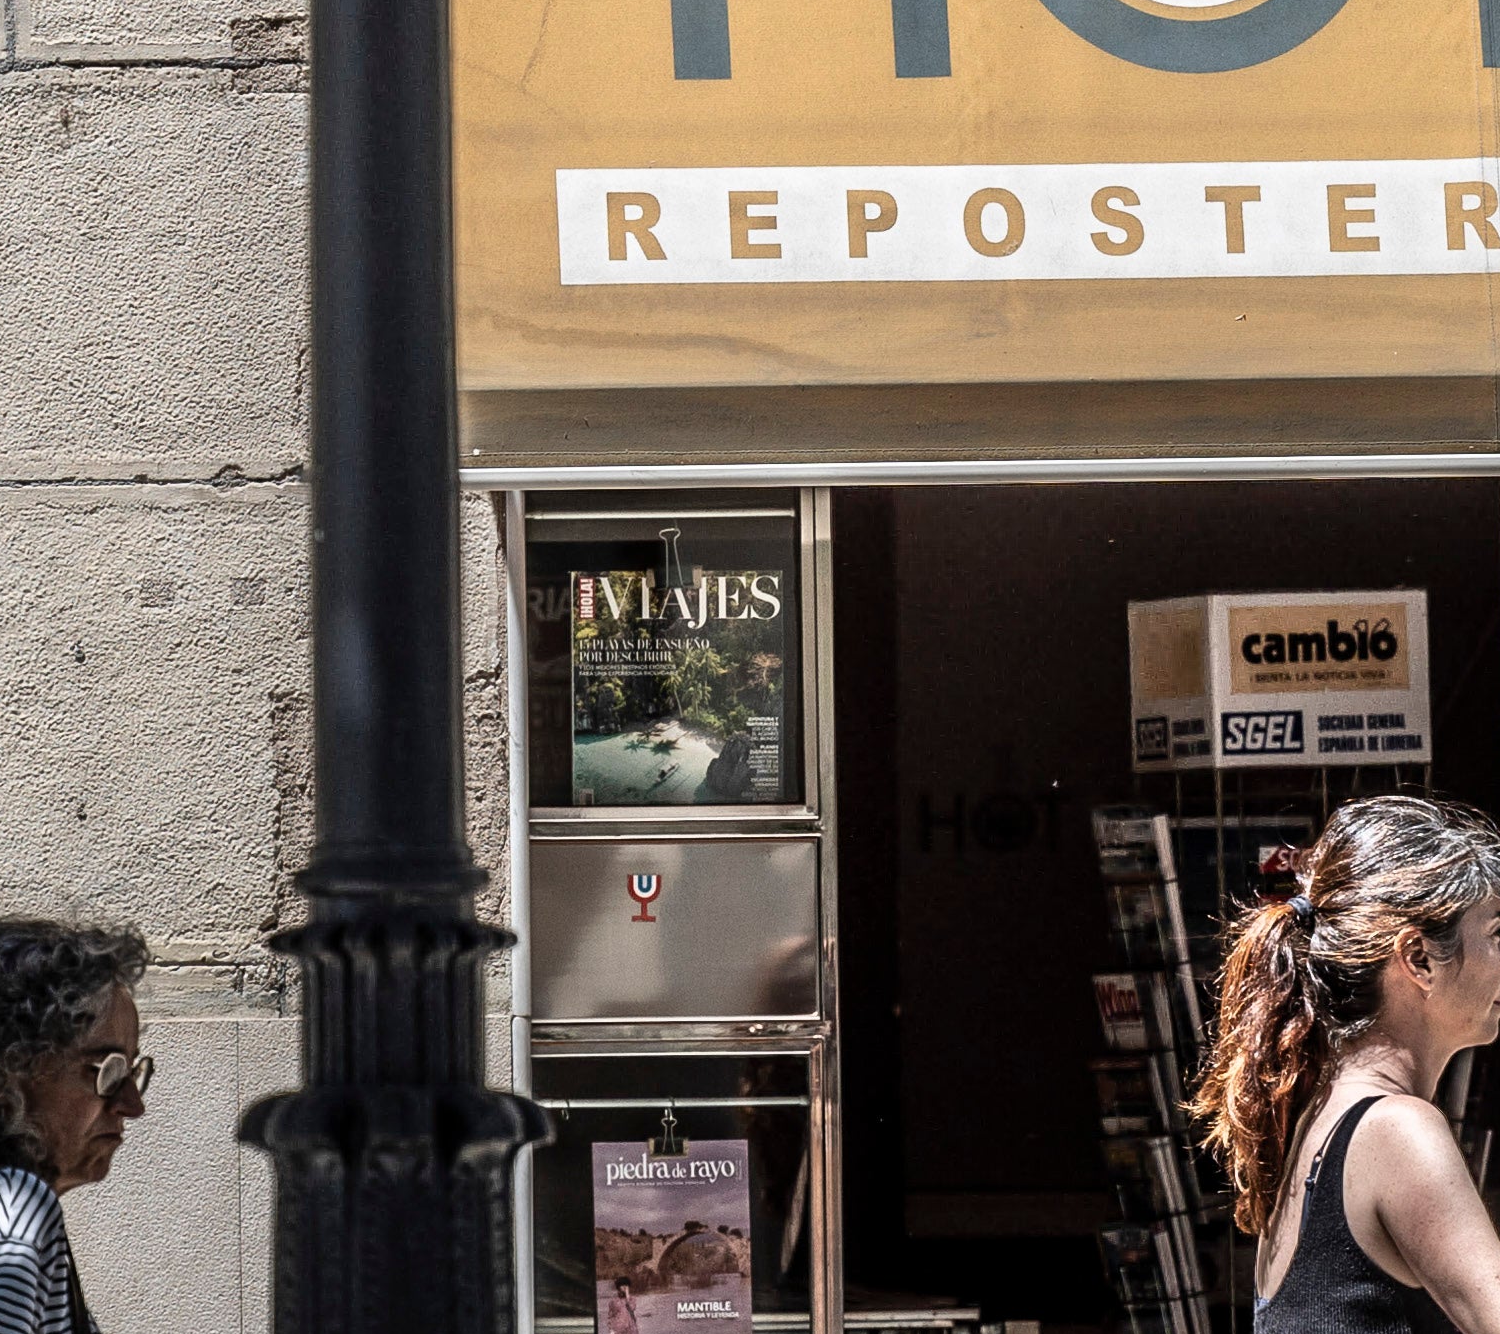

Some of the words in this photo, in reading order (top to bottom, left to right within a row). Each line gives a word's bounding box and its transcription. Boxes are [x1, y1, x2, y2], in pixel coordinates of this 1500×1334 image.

[595, 575, 781, 629] VIAJES
[579, 651, 603, 662] POR
[1224, 715, 1300, 750] SGEL
[606, 1153, 670, 1185] piedra
[672, 1163, 686, 1179] de
[690, 1160, 735, 1183] rayo
[677, 1301, 731, 1312] MANTIBLE
